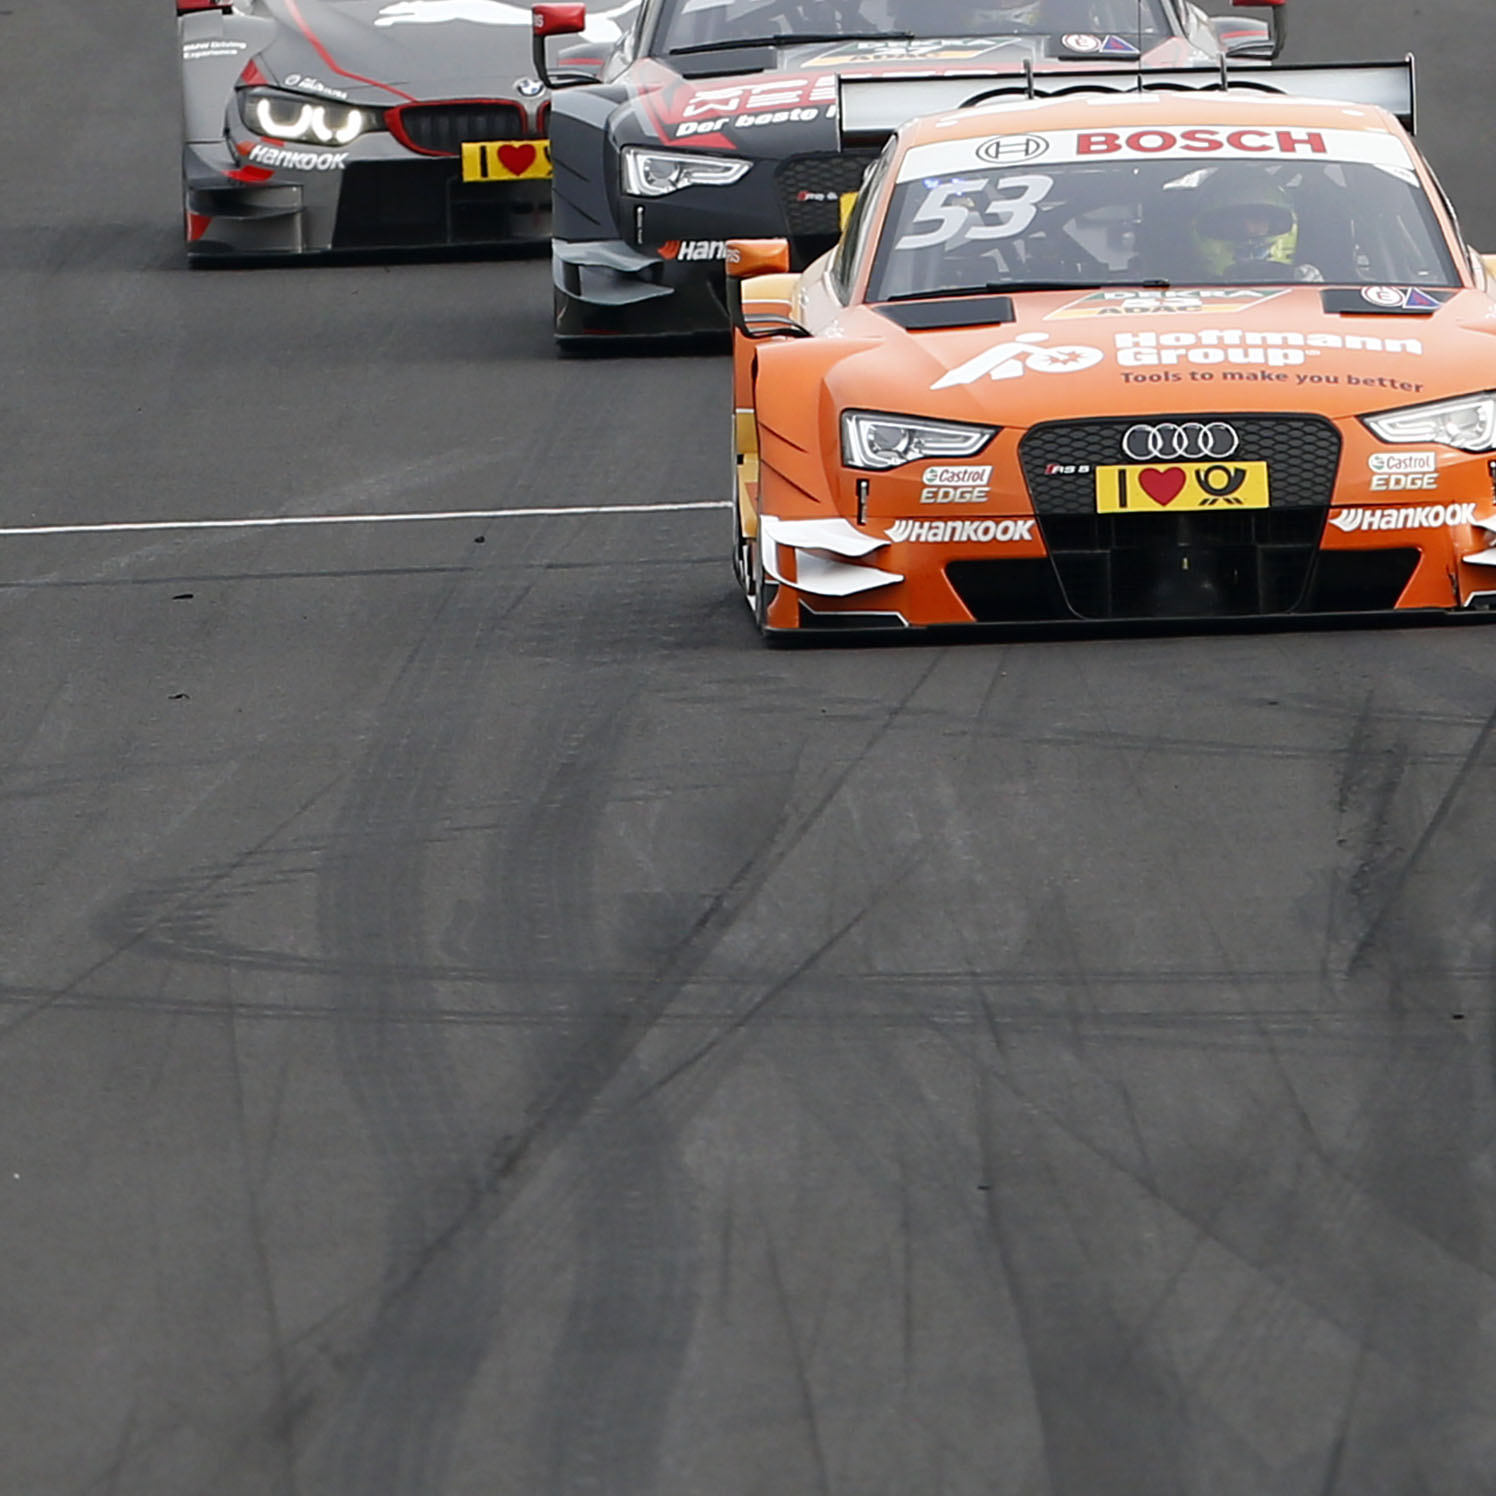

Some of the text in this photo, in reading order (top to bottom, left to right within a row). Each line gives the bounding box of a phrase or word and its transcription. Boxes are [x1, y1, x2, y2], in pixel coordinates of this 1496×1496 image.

[1075, 130, 1329, 156] BOSCH
[895, 174, 1056, 252] 53
[1113, 327, 1424, 355] Hoffmann
[1115, 346, 1304, 368] Group
[1121, 370, 1425, 394] Tools to make you better
[1386, 454, 1432, 471] Castrol
[938, 467, 987, 485] Castrol
[1369, 472, 1440, 492] EDGE
[920, 486, 993, 504] EDGE
[1118, 468, 1129, 510] I
